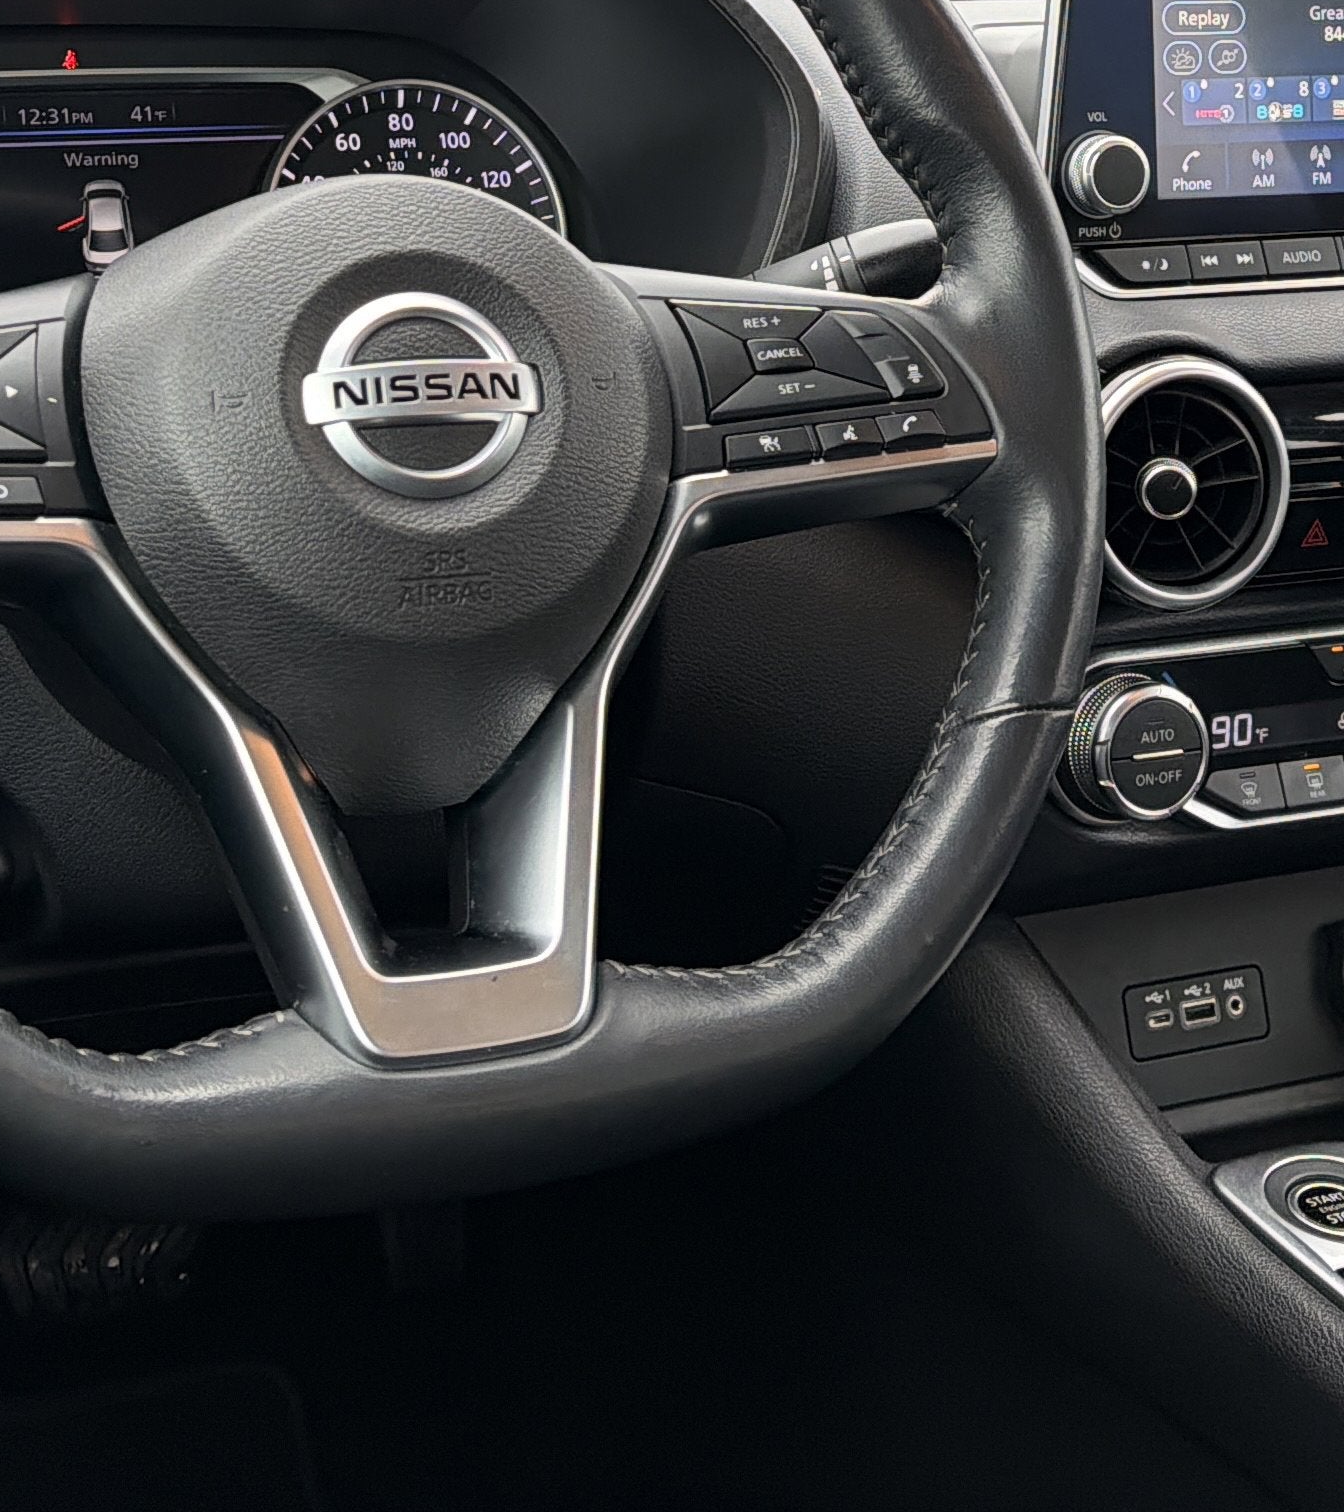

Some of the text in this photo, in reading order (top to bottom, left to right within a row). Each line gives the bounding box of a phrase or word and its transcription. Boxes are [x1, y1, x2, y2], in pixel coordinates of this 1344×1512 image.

[1178, 9, 1230, 29] Replay
[1234, 82, 1245, 99] 2
[1298, 81, 1310, 97] 8
[387, 113, 414, 134] 80
[1087, 111, 1108, 123] VOL
[335, 132, 361, 153] 60
[388, 137, 416, 149] MPH
[438, 131, 471, 151] 100
[63, 150, 140, 170] Warning
[386, 160, 405, 173] 120
[429, 164, 449, 179] 160
[1312, 171, 1332, 185] FM
[481, 170, 512, 189] 120
[1173, 178, 1212, 192] Phone
[1253, 173, 1275, 188] AM
[1079, 226, 1106, 238] PUSH
[1282, 249, 1322, 264] AUDIO
[743, 316, 770, 329] RES
[757, 346, 804, 360] CANCEL
[332, 371, 523, 409] NISSAN
[778, 381, 801, 395] SET
[423, 548, 468, 573] SRS
[397, 584, 495, 609] AIRBAG
[1141, 728, 1175, 744] AUTO
[1223, 976, 1245, 990] AUX
